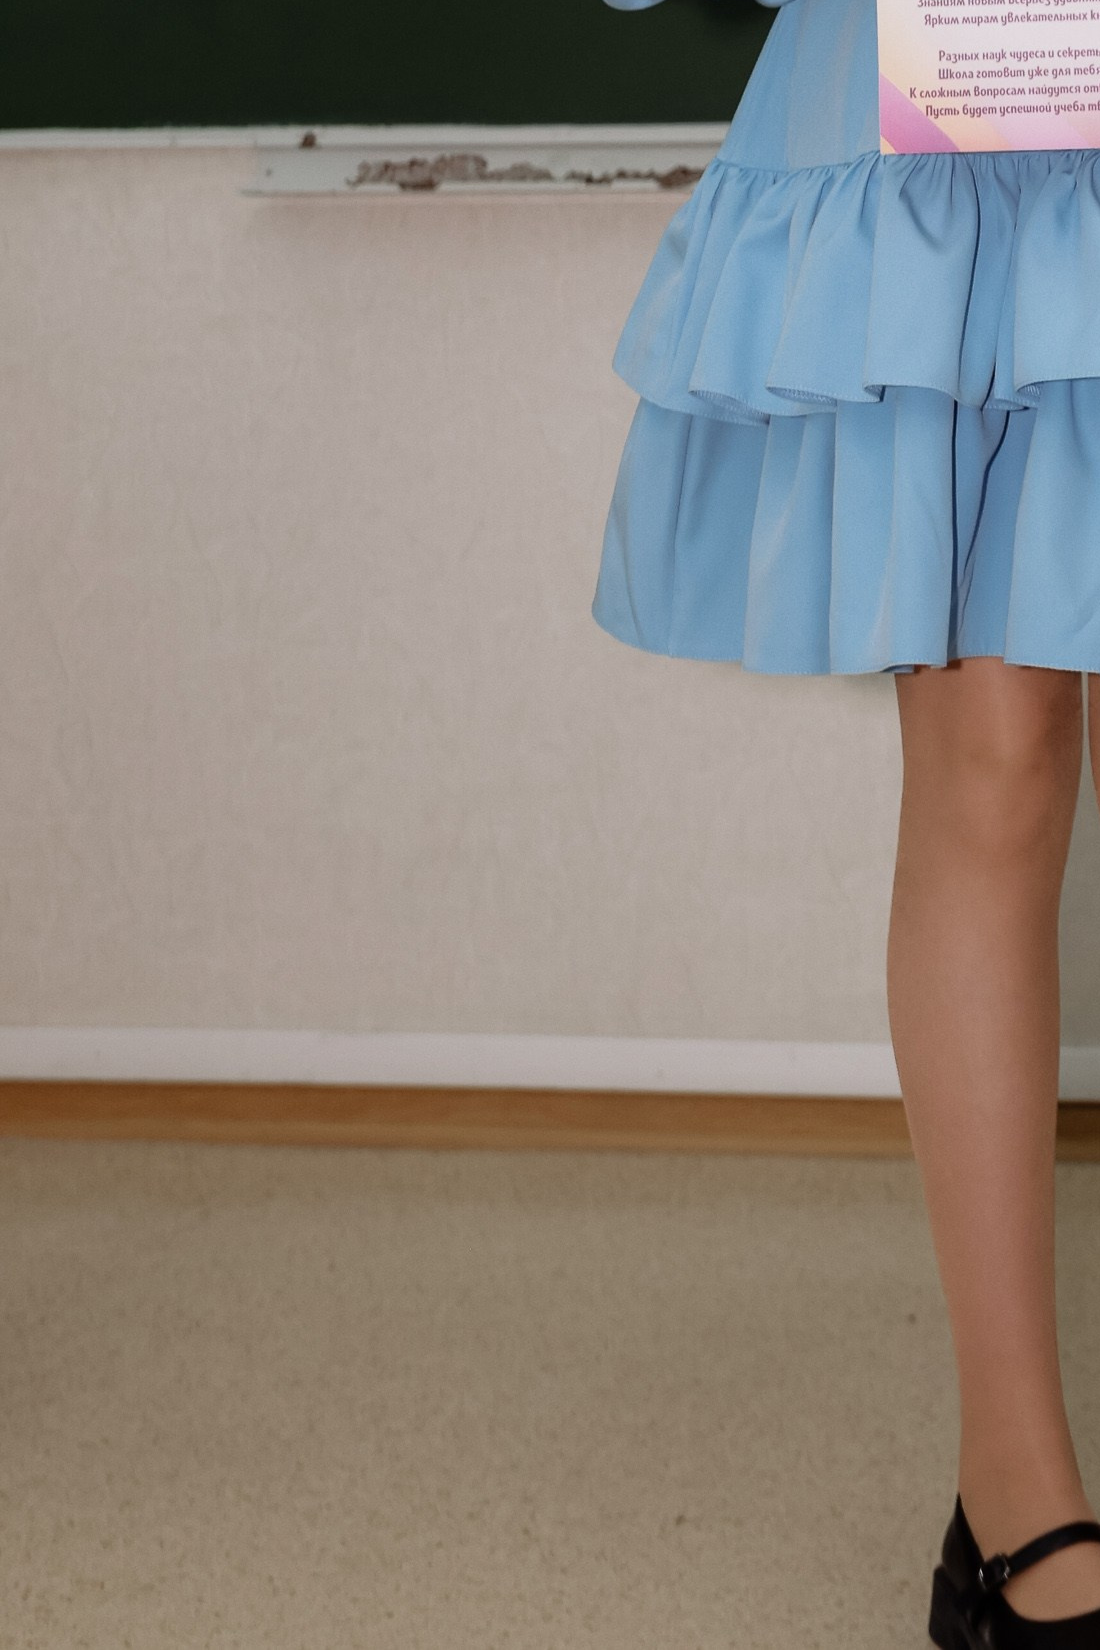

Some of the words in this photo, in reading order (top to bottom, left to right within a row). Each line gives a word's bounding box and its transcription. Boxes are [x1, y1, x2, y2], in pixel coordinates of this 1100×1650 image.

[924, 14, 960, 28] Ярким
[961, 15, 999, 26] мирам
[1001, 11, 1088, 26] увлекательных
[938, 50, 979, 64] Разных
[982, 49, 1007, 62] наук
[1009, 51, 1046, 61] чудеса
[1048, 50, 1055, 58] и
[938, 68, 974, 80] Школа
[976, 66, 1025, 79] готовит
[1028, 66, 1049, 79] уже
[1051, 67, 1071, 78] для
[909, 87, 917, 99] К
[919, 87, 971, 99] сложным
[973, 85, 1026, 99] вопросам
[1028, 83, 1081, 97] найдутся
[925, 105, 960, 119] Пусть
[962, 104, 997, 118] будет
[999, 102, 1051, 116] успешной
[1053, 101, 1086, 115] учеба
